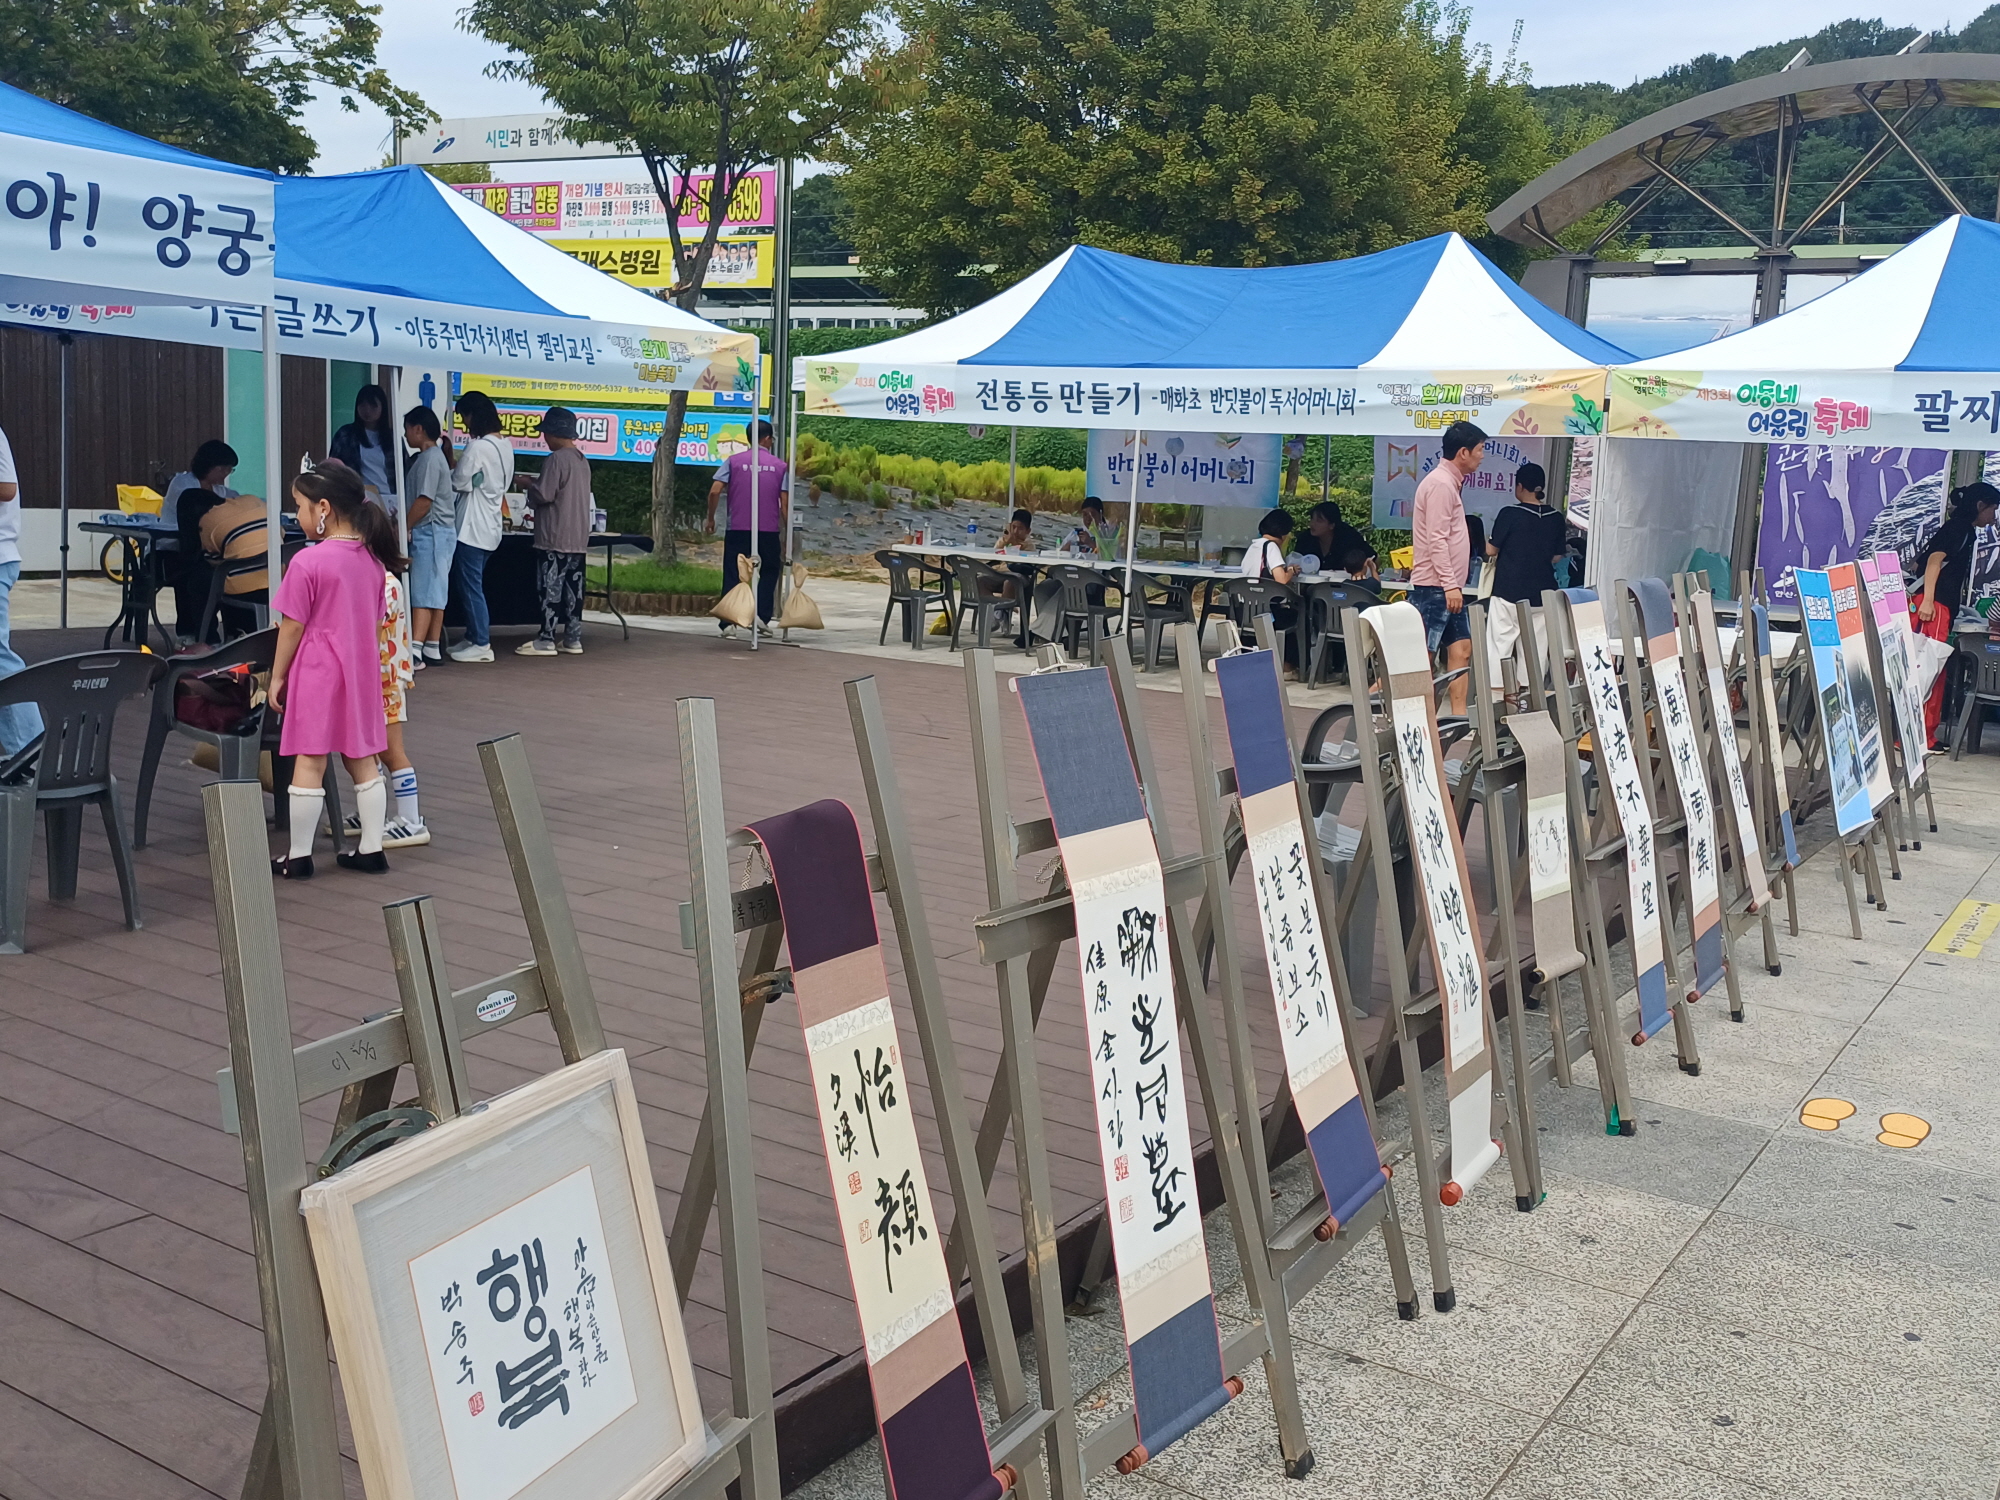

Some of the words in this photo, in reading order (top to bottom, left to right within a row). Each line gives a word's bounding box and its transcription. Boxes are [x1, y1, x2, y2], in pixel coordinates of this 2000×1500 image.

[485, 129, 522, 148] 시민과
[878, 370, 913, 393] 이동네
[1420, 383, 1463, 406] 함께
[1696, 388, 1731, 401] 제3회
[1736, 379, 1798, 408] 이동네
[886, 393, 920, 416] 어울림
[923, 384, 955, 414] 축제
[1747, 408, 1808, 438] 어울림
[1813, 397, 1869, 435] 축제
[732, 898, 768, 927] 록구청
